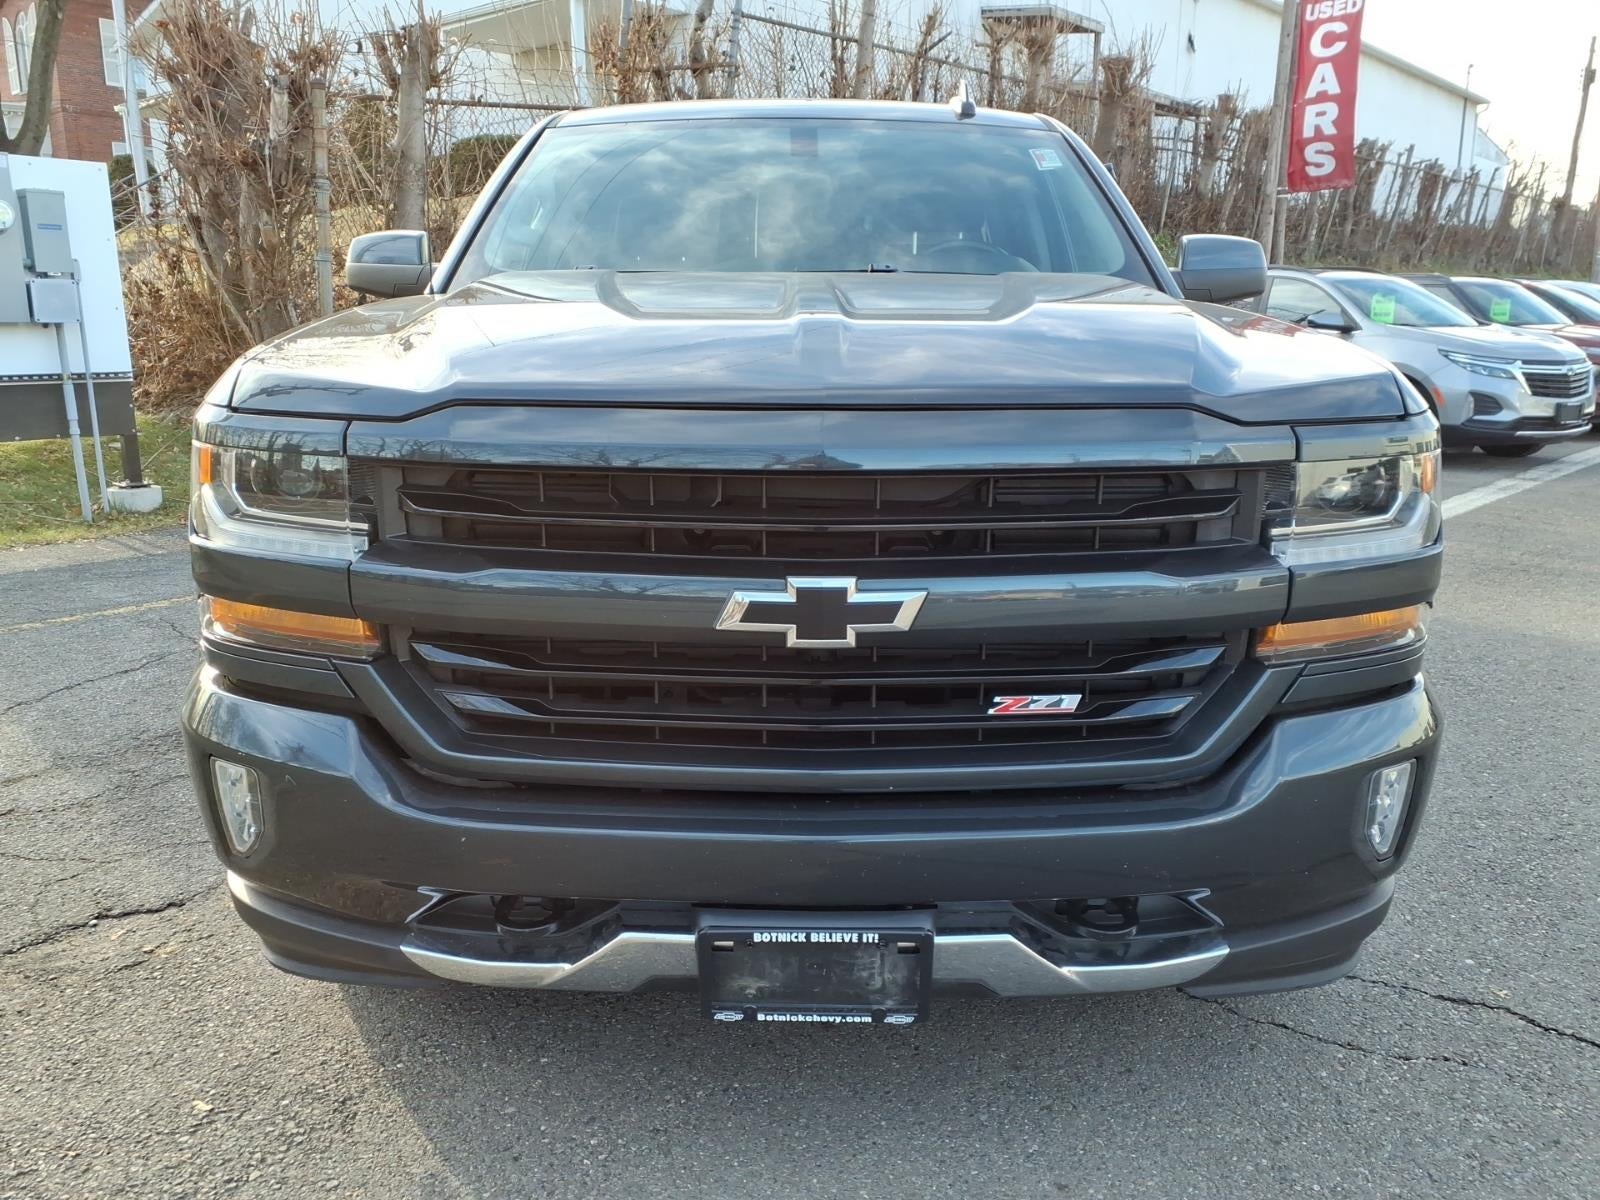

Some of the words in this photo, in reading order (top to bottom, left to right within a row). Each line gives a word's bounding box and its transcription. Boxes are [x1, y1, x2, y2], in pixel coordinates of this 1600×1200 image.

[1305, 0, 1362, 21] USED
[1303, 22, 1348, 176] CARS
[987, 694, 1082, 714] Z71
[753, 932, 806, 943] BOTNICK
[811, 932, 859, 943] BELIEVE
[863, 932, 879, 943] IT!
[757, 1013, 871, 1023] Botnickchevy.com
